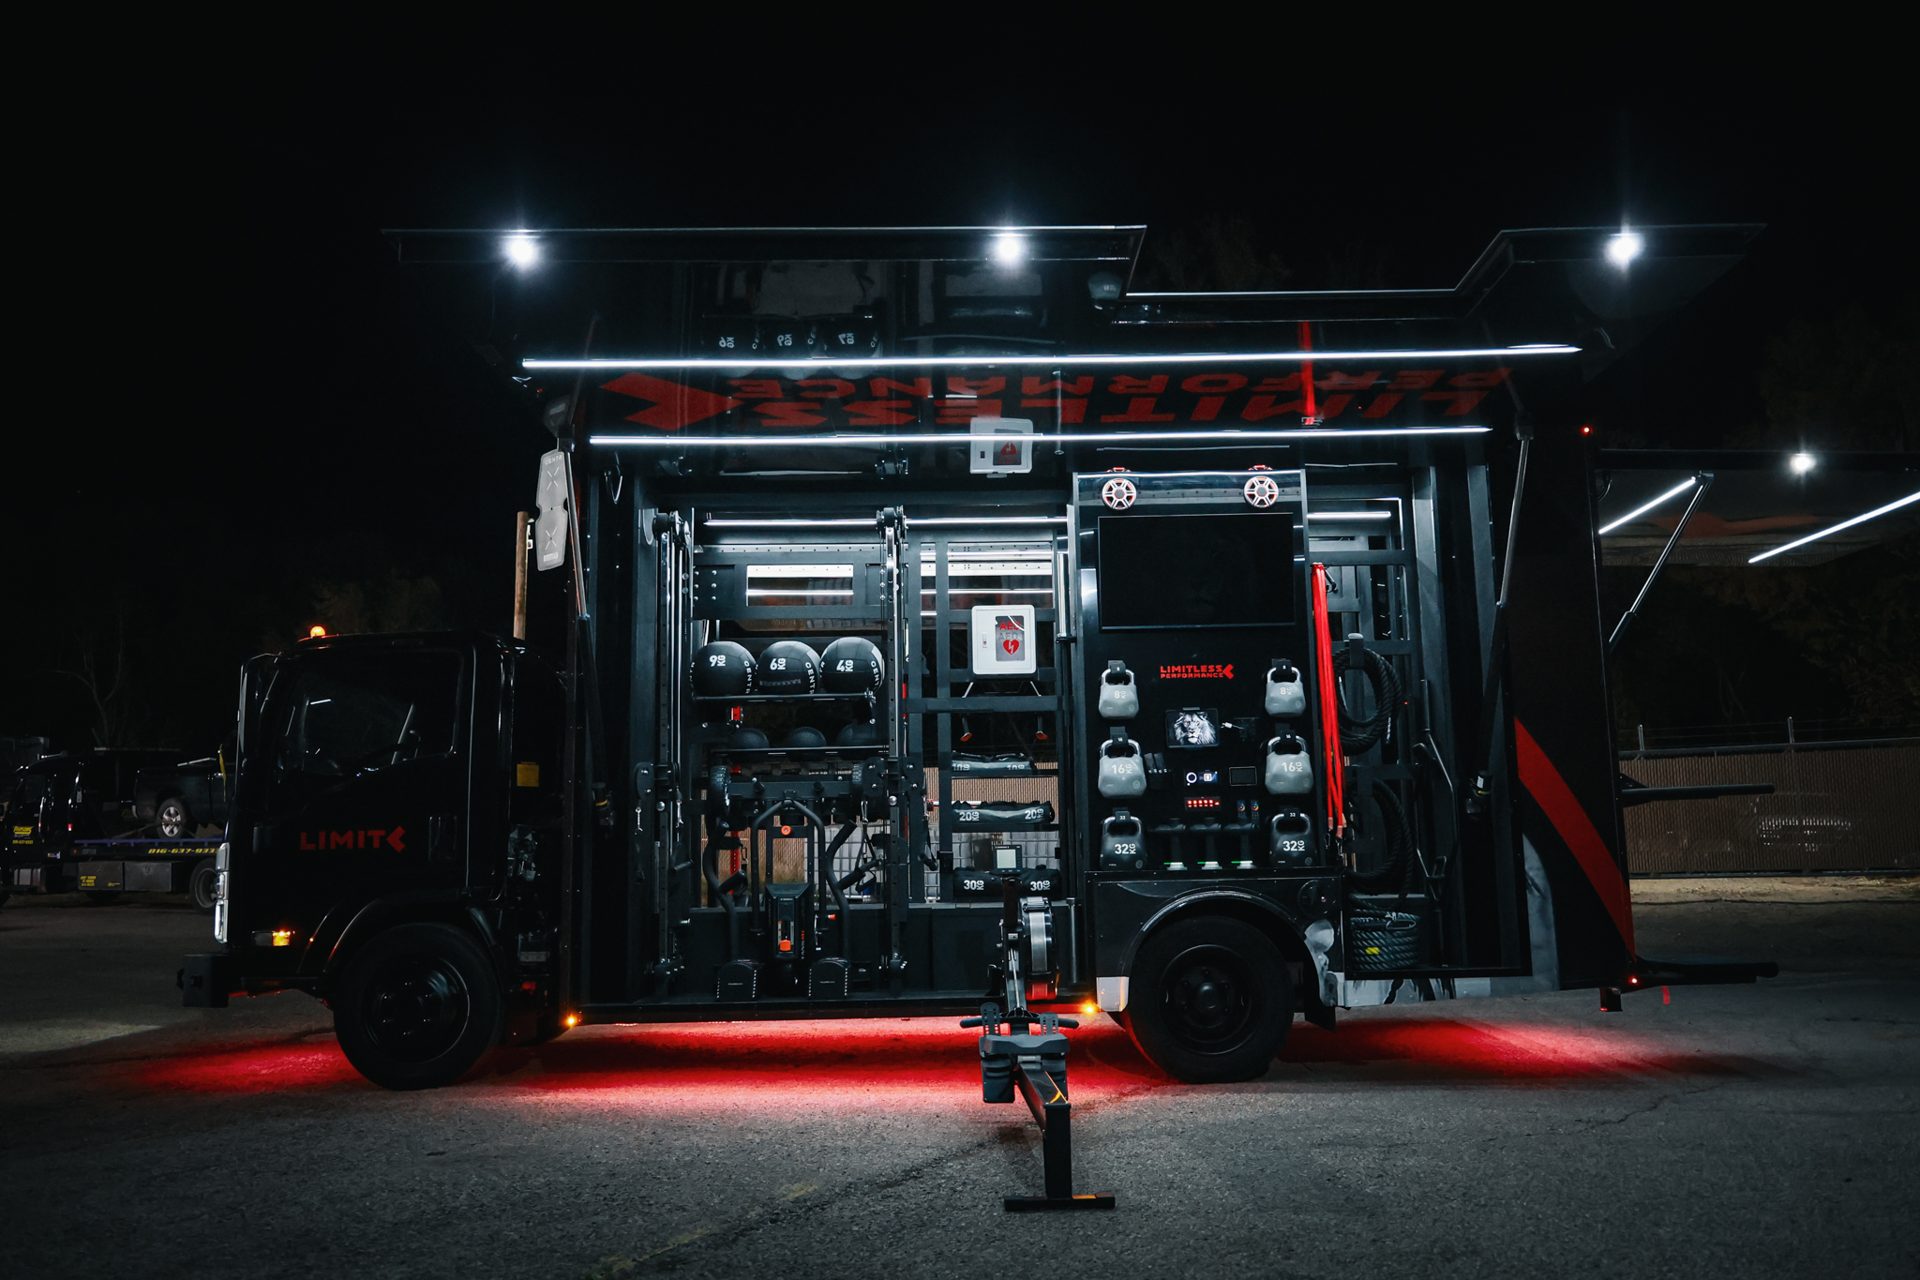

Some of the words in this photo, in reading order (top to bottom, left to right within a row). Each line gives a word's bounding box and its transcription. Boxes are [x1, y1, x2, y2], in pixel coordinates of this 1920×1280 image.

[727, 367, 1514, 399] PERFORMANCE
[753, 390, 1497, 427] LIMITLESS
[1160, 665, 1223, 673] LIMITLESS
[299, 829, 387, 850] LIMIT
